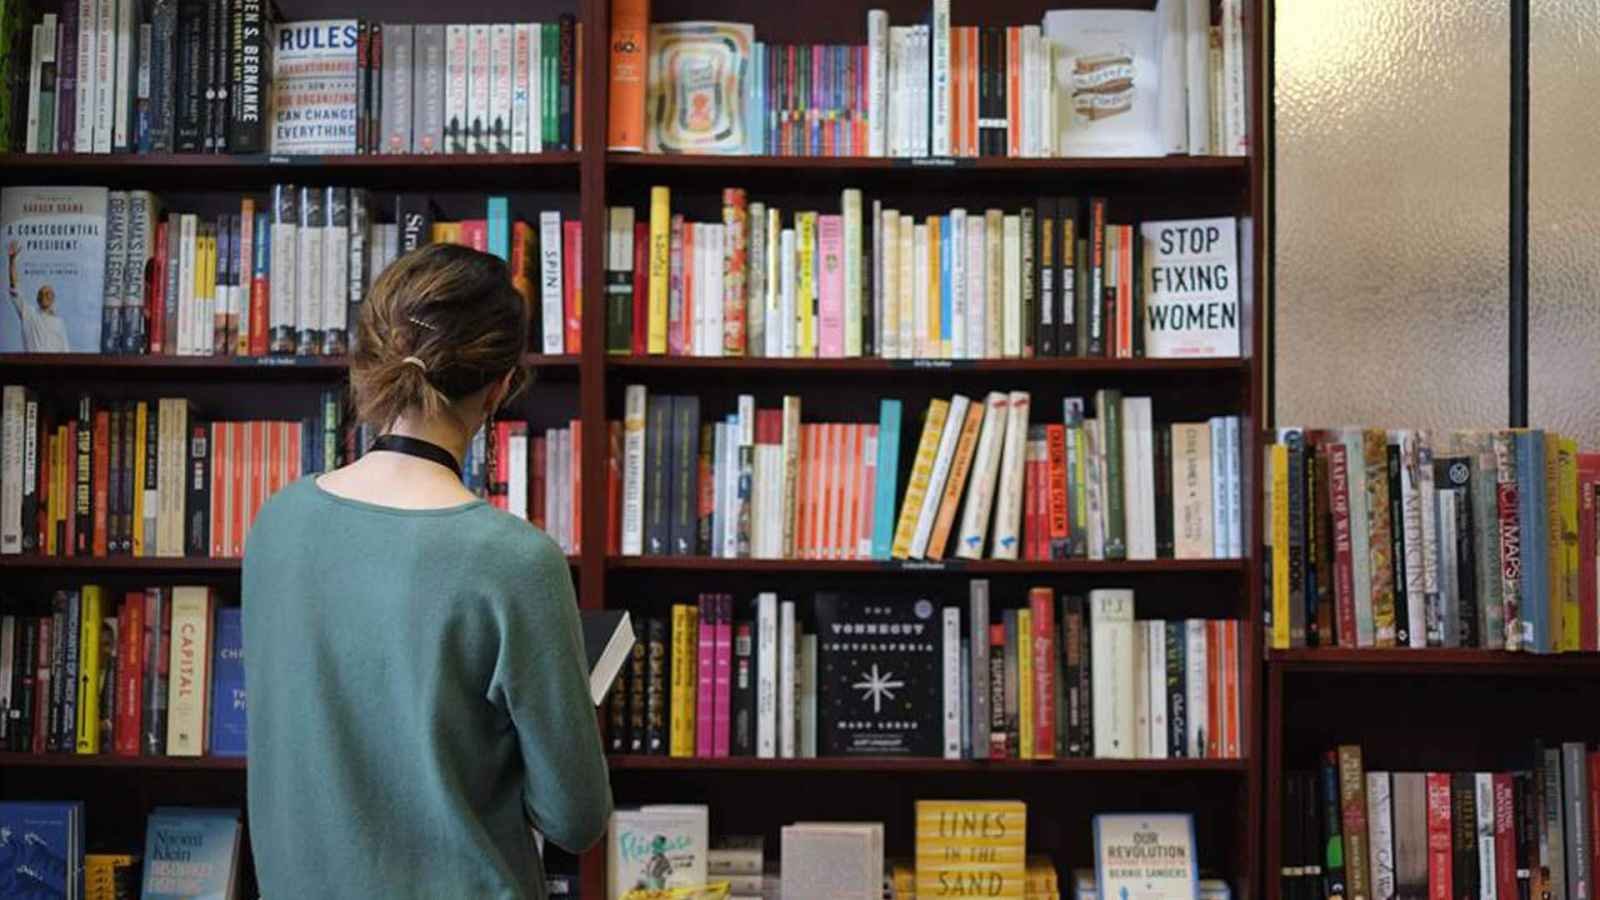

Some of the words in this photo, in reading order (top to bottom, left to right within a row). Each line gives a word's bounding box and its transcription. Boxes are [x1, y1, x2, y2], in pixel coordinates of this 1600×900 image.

[280, 26, 357, 51] RULES
[243, 45, 258, 121] BERNANKE
[278, 111, 301, 122] CAN
[7, 225, 13, 236] A
[18, 224, 99, 236] CONSEQUENTIAL
[1160, 228, 1219, 255] STOP
[27, 240, 79, 251] PRESIDENT
[546, 250, 558, 288] SPIN
[1152, 265, 1228, 292] FIXING
[1148, 303, 1235, 331] WOMEN
[1332, 452, 1344, 491] MAPS
[1335, 495, 1346, 513] OF
[1336, 516, 1349, 552] WAR
[1404, 495, 1423, 599] MEDICINE
[1504, 526, 1520, 579] MAPS
[1290, 545, 1303, 593] BOOK
[179, 623, 195, 697] CAPITAL
[991, 657, 1005, 727] SUPERGIRLS
[939, 812, 1007, 840] LINES
[1133, 831, 1159, 845] OUR
[154, 846, 191, 861] Klein
[944, 847, 961, 863] IN
[967, 846, 997, 863] THE
[1108, 846, 1186, 858] REVOLUTION
[936, 872, 1003, 897] SAND
[1144, 868, 1187, 878] SANDERS
